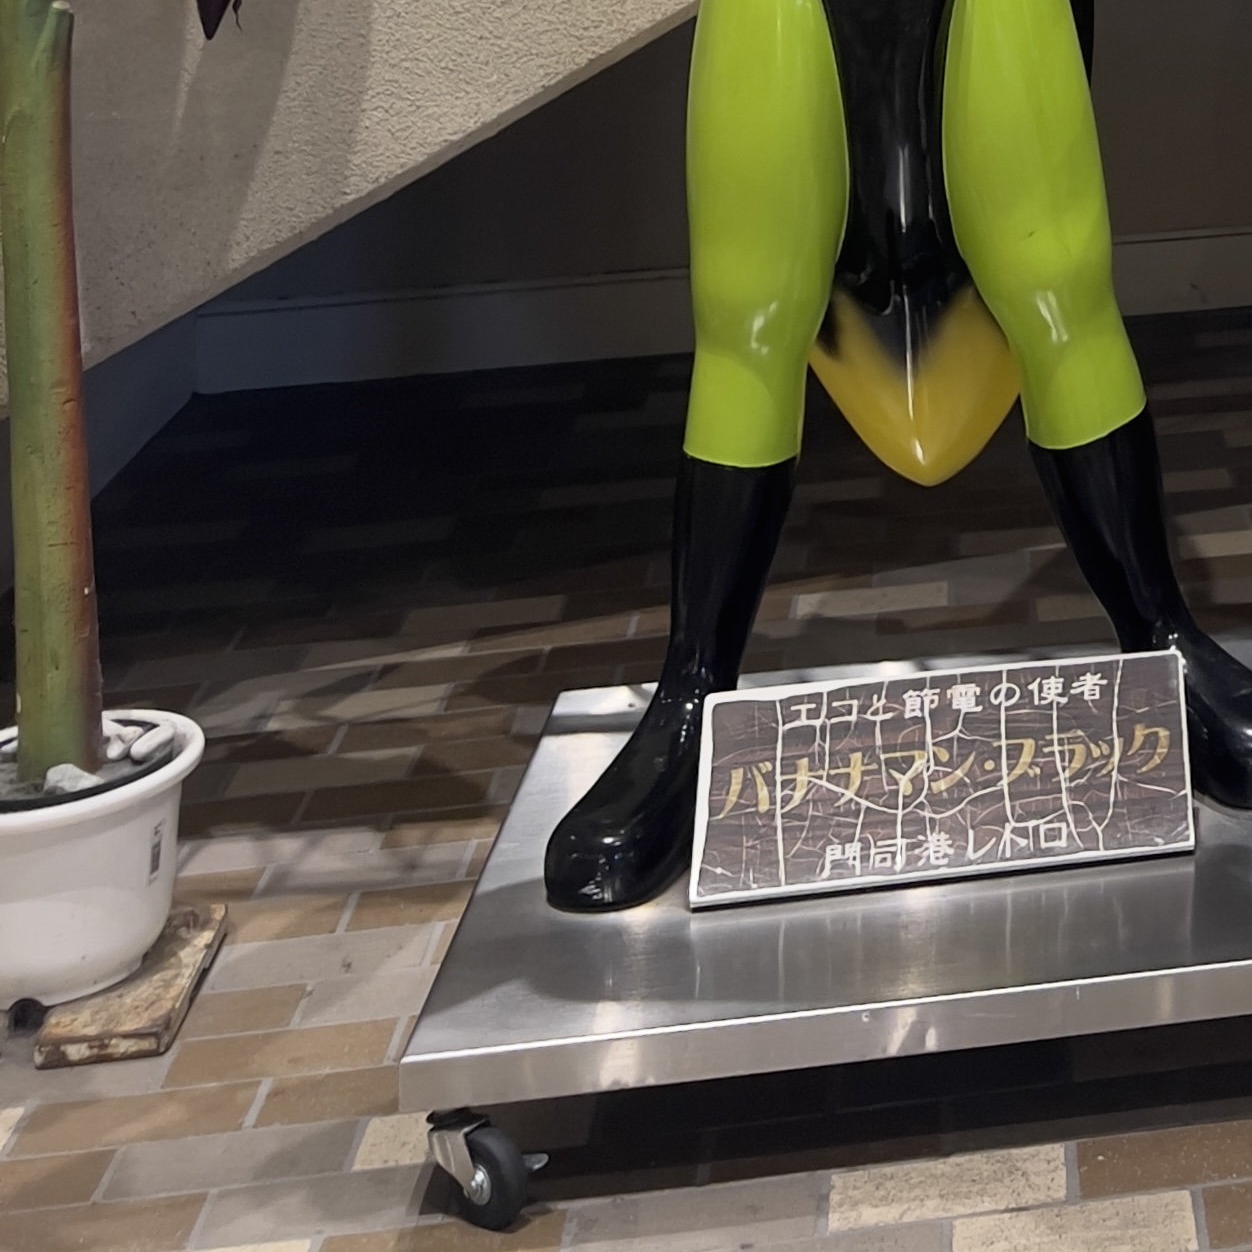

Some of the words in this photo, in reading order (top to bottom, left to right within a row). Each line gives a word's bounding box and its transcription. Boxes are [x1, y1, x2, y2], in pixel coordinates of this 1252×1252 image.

[786, 671, 1108, 728] エコと節電の使者
[718, 722, 1172, 819] バナナマン・ブラック
